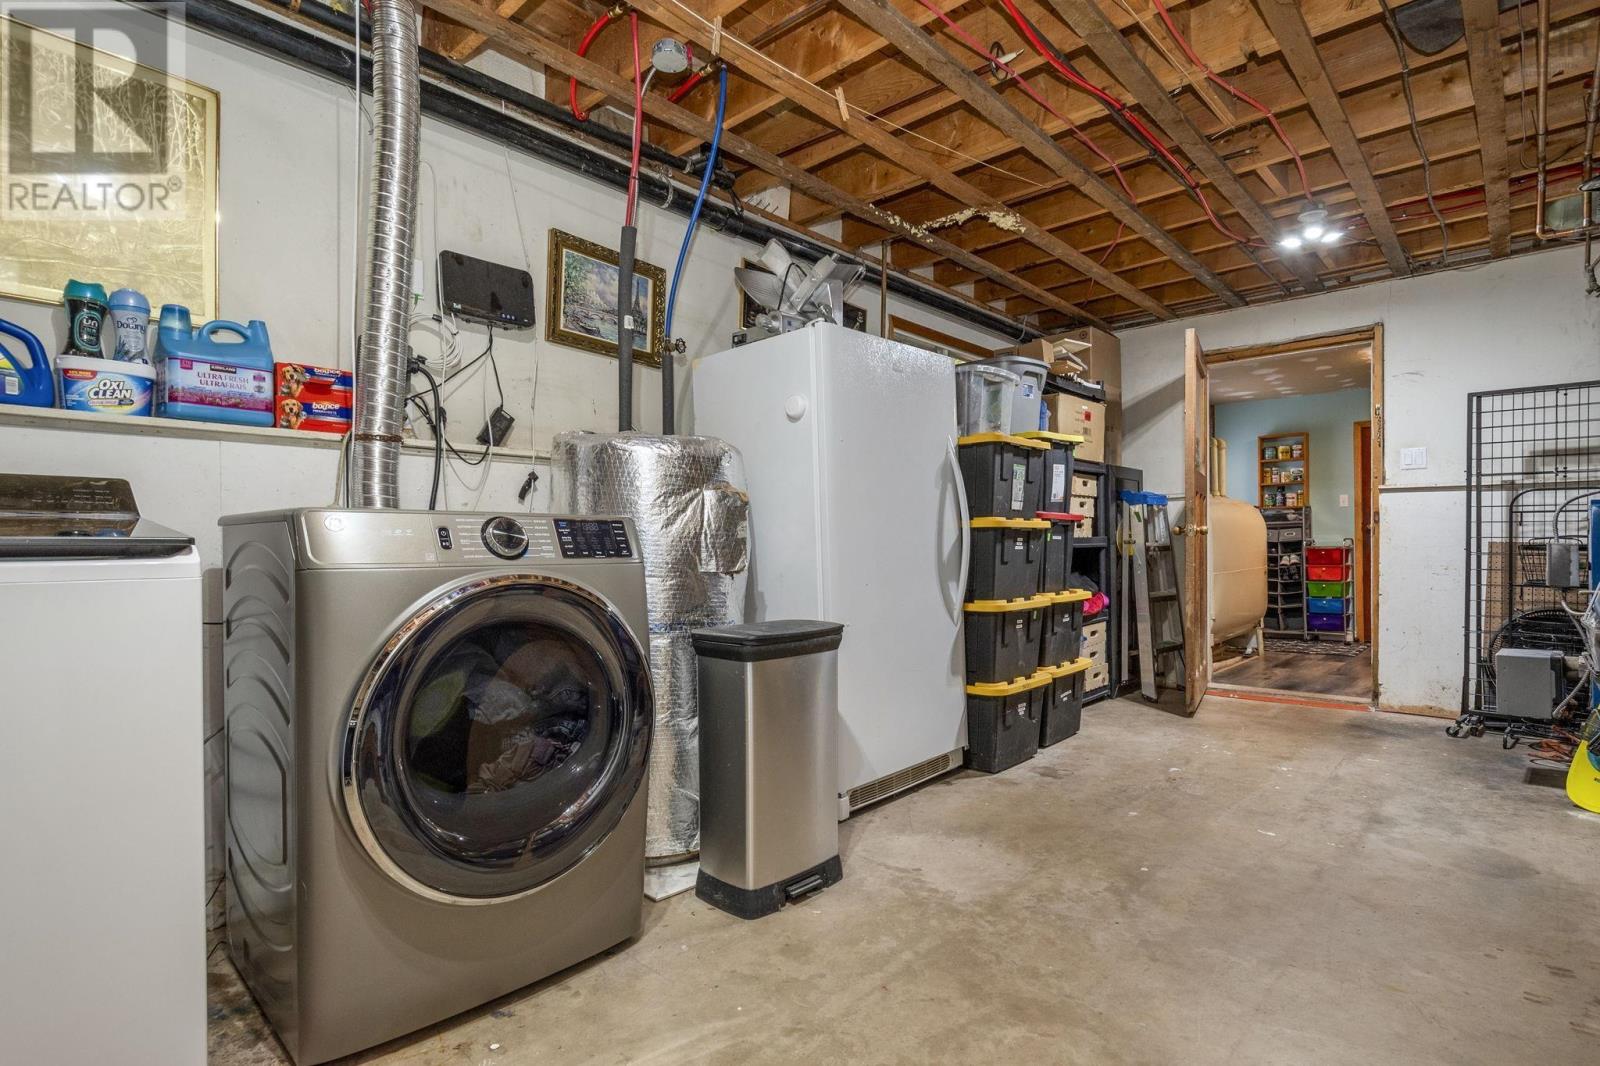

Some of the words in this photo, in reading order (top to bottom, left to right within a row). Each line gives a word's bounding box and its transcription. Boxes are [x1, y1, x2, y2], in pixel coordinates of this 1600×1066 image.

[116, 320, 146, 334] Downy
[197, 371, 223, 381] ULTRA
[223, 375, 249, 384] FRESH
[98, 379, 124, 390] OXI
[199, 379, 226, 388] ULTRA
[88, 388, 132, 399] CLEAN
[312, 402, 340, 411] bounce
